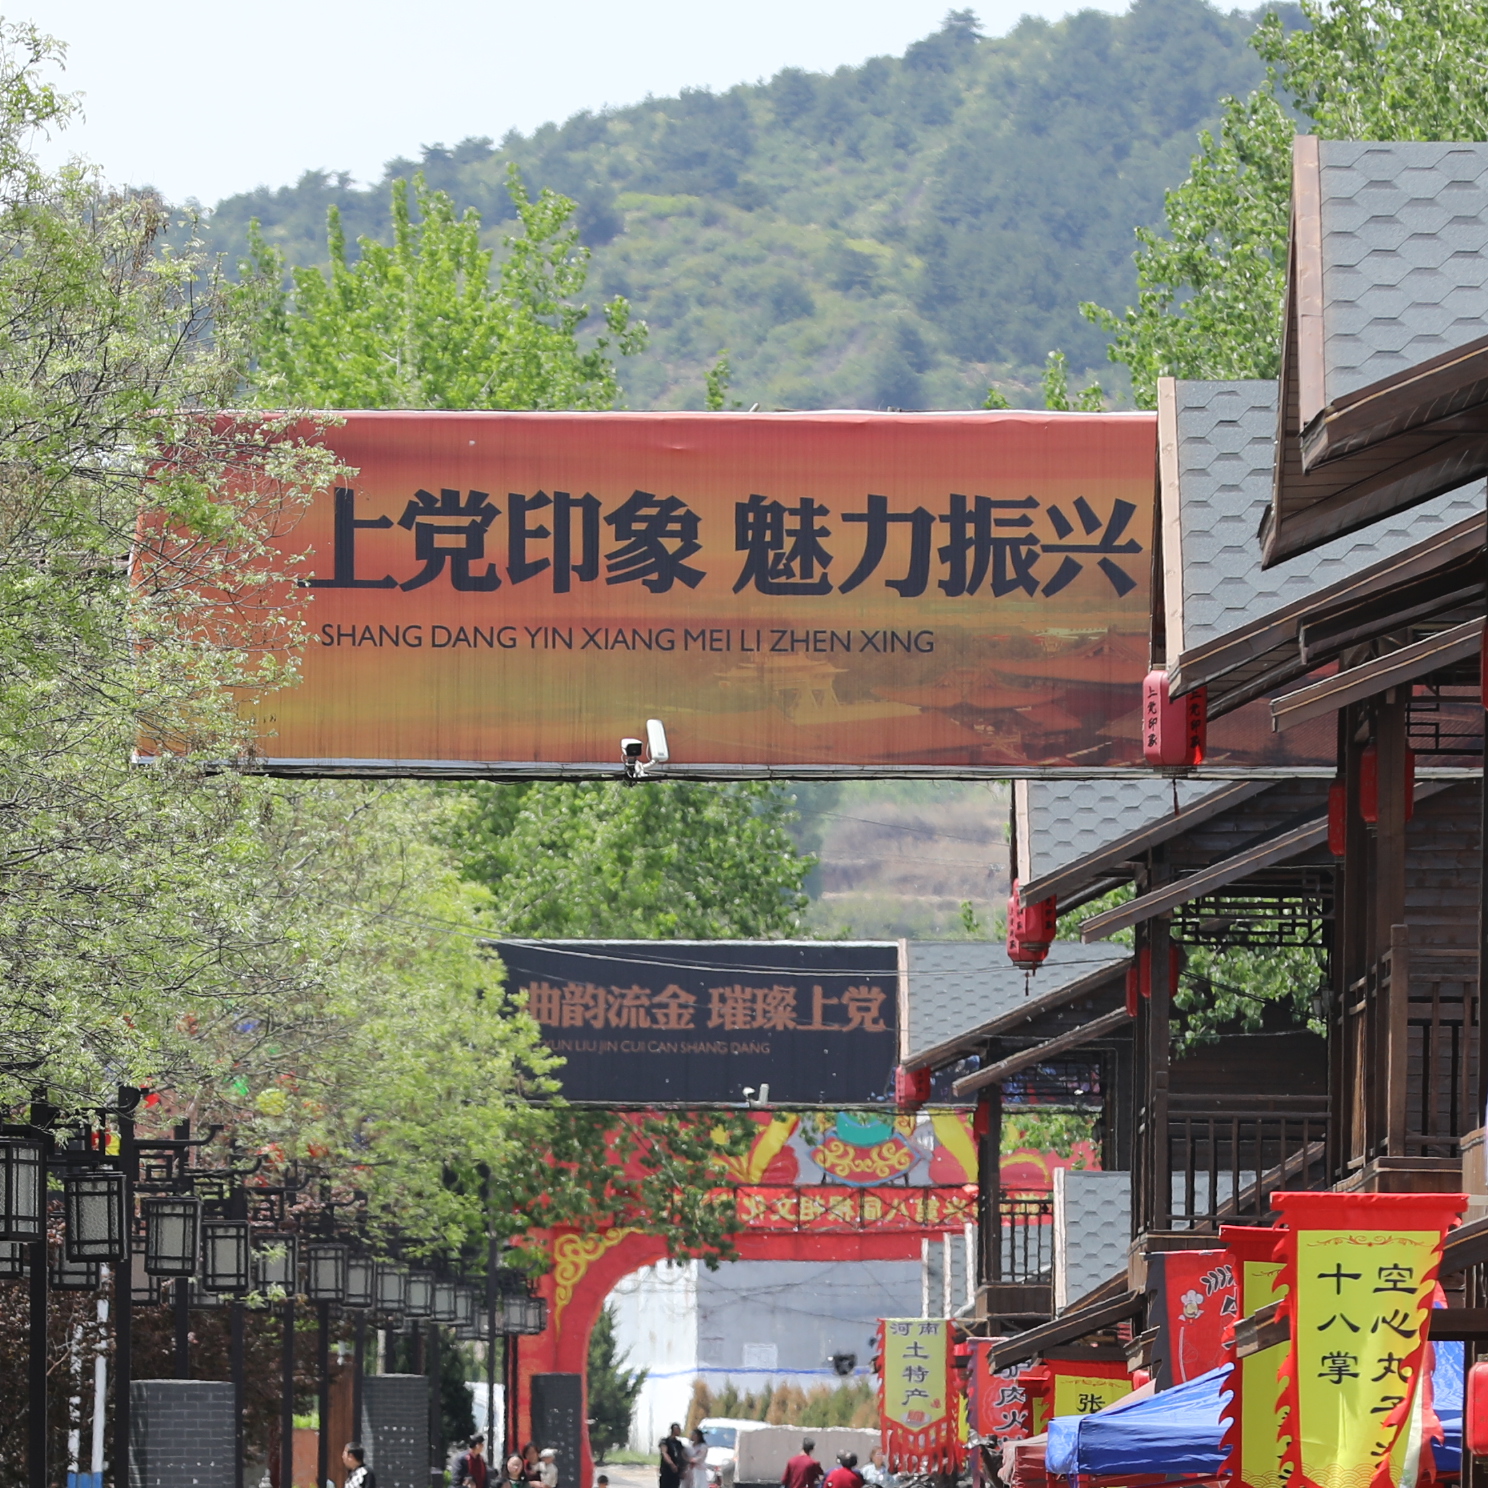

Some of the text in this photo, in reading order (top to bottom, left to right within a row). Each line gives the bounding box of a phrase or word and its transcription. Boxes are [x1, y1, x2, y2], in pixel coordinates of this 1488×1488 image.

[296, 486, 1143, 598] 上党印象 魅力振兴
[320, 622, 935, 654] SHANG DANG YIN XIANG MEI LI ZHEN XING
[1147, 685, 1158, 748] 上党印象
[519, 981, 888, 1033] 曲韵流金 璀璨上党
[575, 1040, 598, 1052] LIU
[599, 1040, 619, 1054] JIN
[620, 1040, 645, 1052] CUI
[648, 1041, 678, 1053] CAN
[680, 1041, 729, 1054] SHANG
[730, 1041, 771, 1054] DANG
[889, 1321, 940, 1337] 河南
[1317, 1262, 1363, 1385] 十八掌
[901, 1340, 930, 1406] 土特产
[1077, 1393, 1106, 1414] 张
